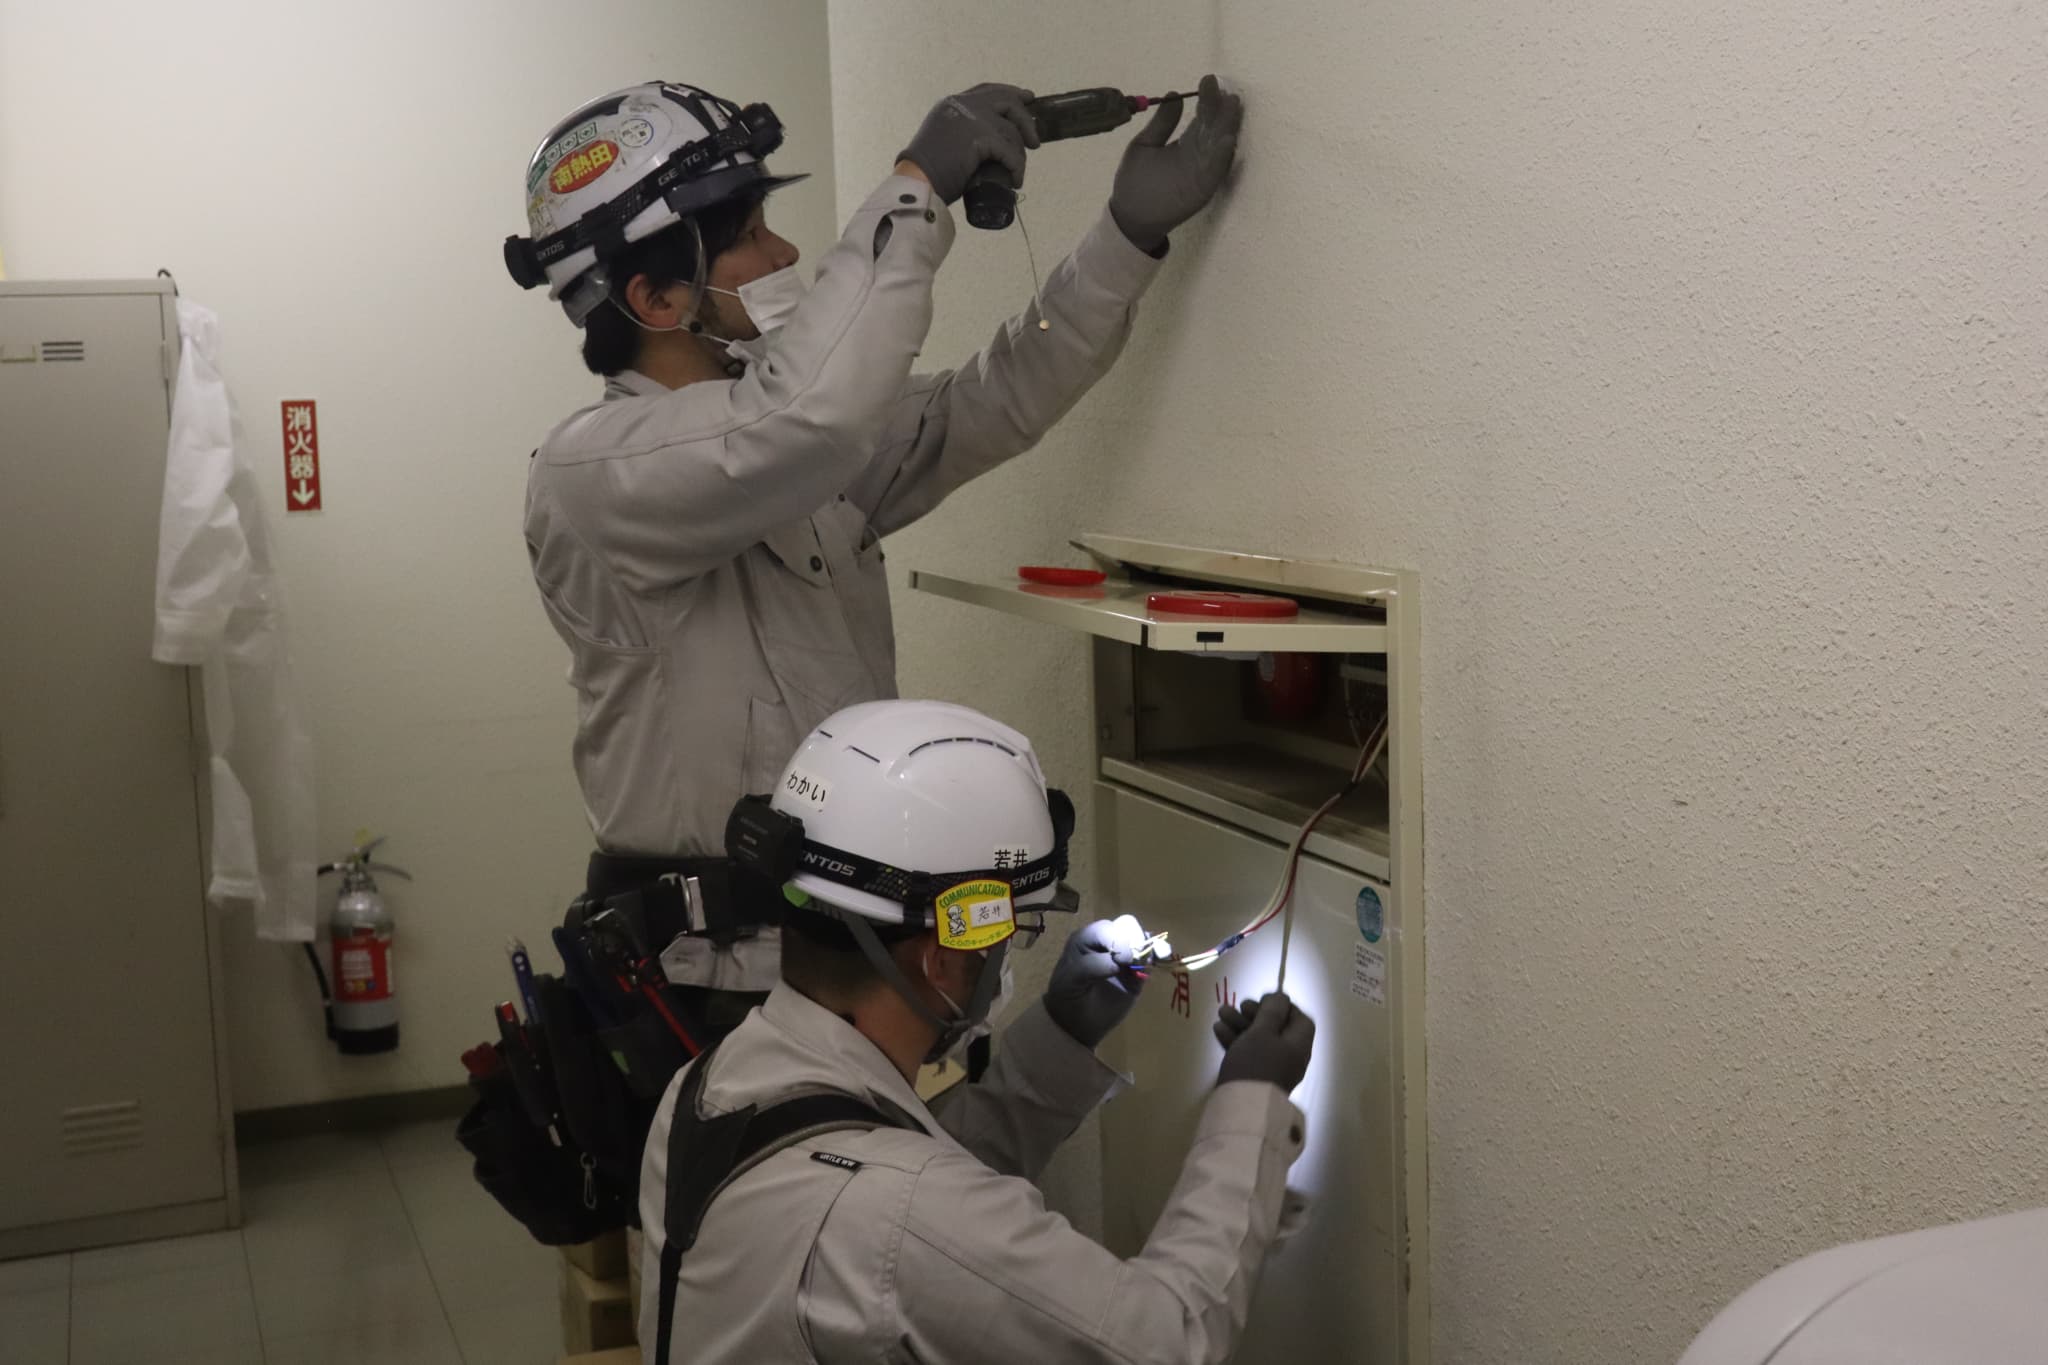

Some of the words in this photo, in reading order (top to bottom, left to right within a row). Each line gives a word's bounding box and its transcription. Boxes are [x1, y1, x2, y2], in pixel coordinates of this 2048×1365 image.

[286, 406, 314, 479] 消火器
[786, 770, 826, 802] わかい
[994, 848, 1028, 870] 若井
[938, 883, 1008, 909] COMMUNICATION
